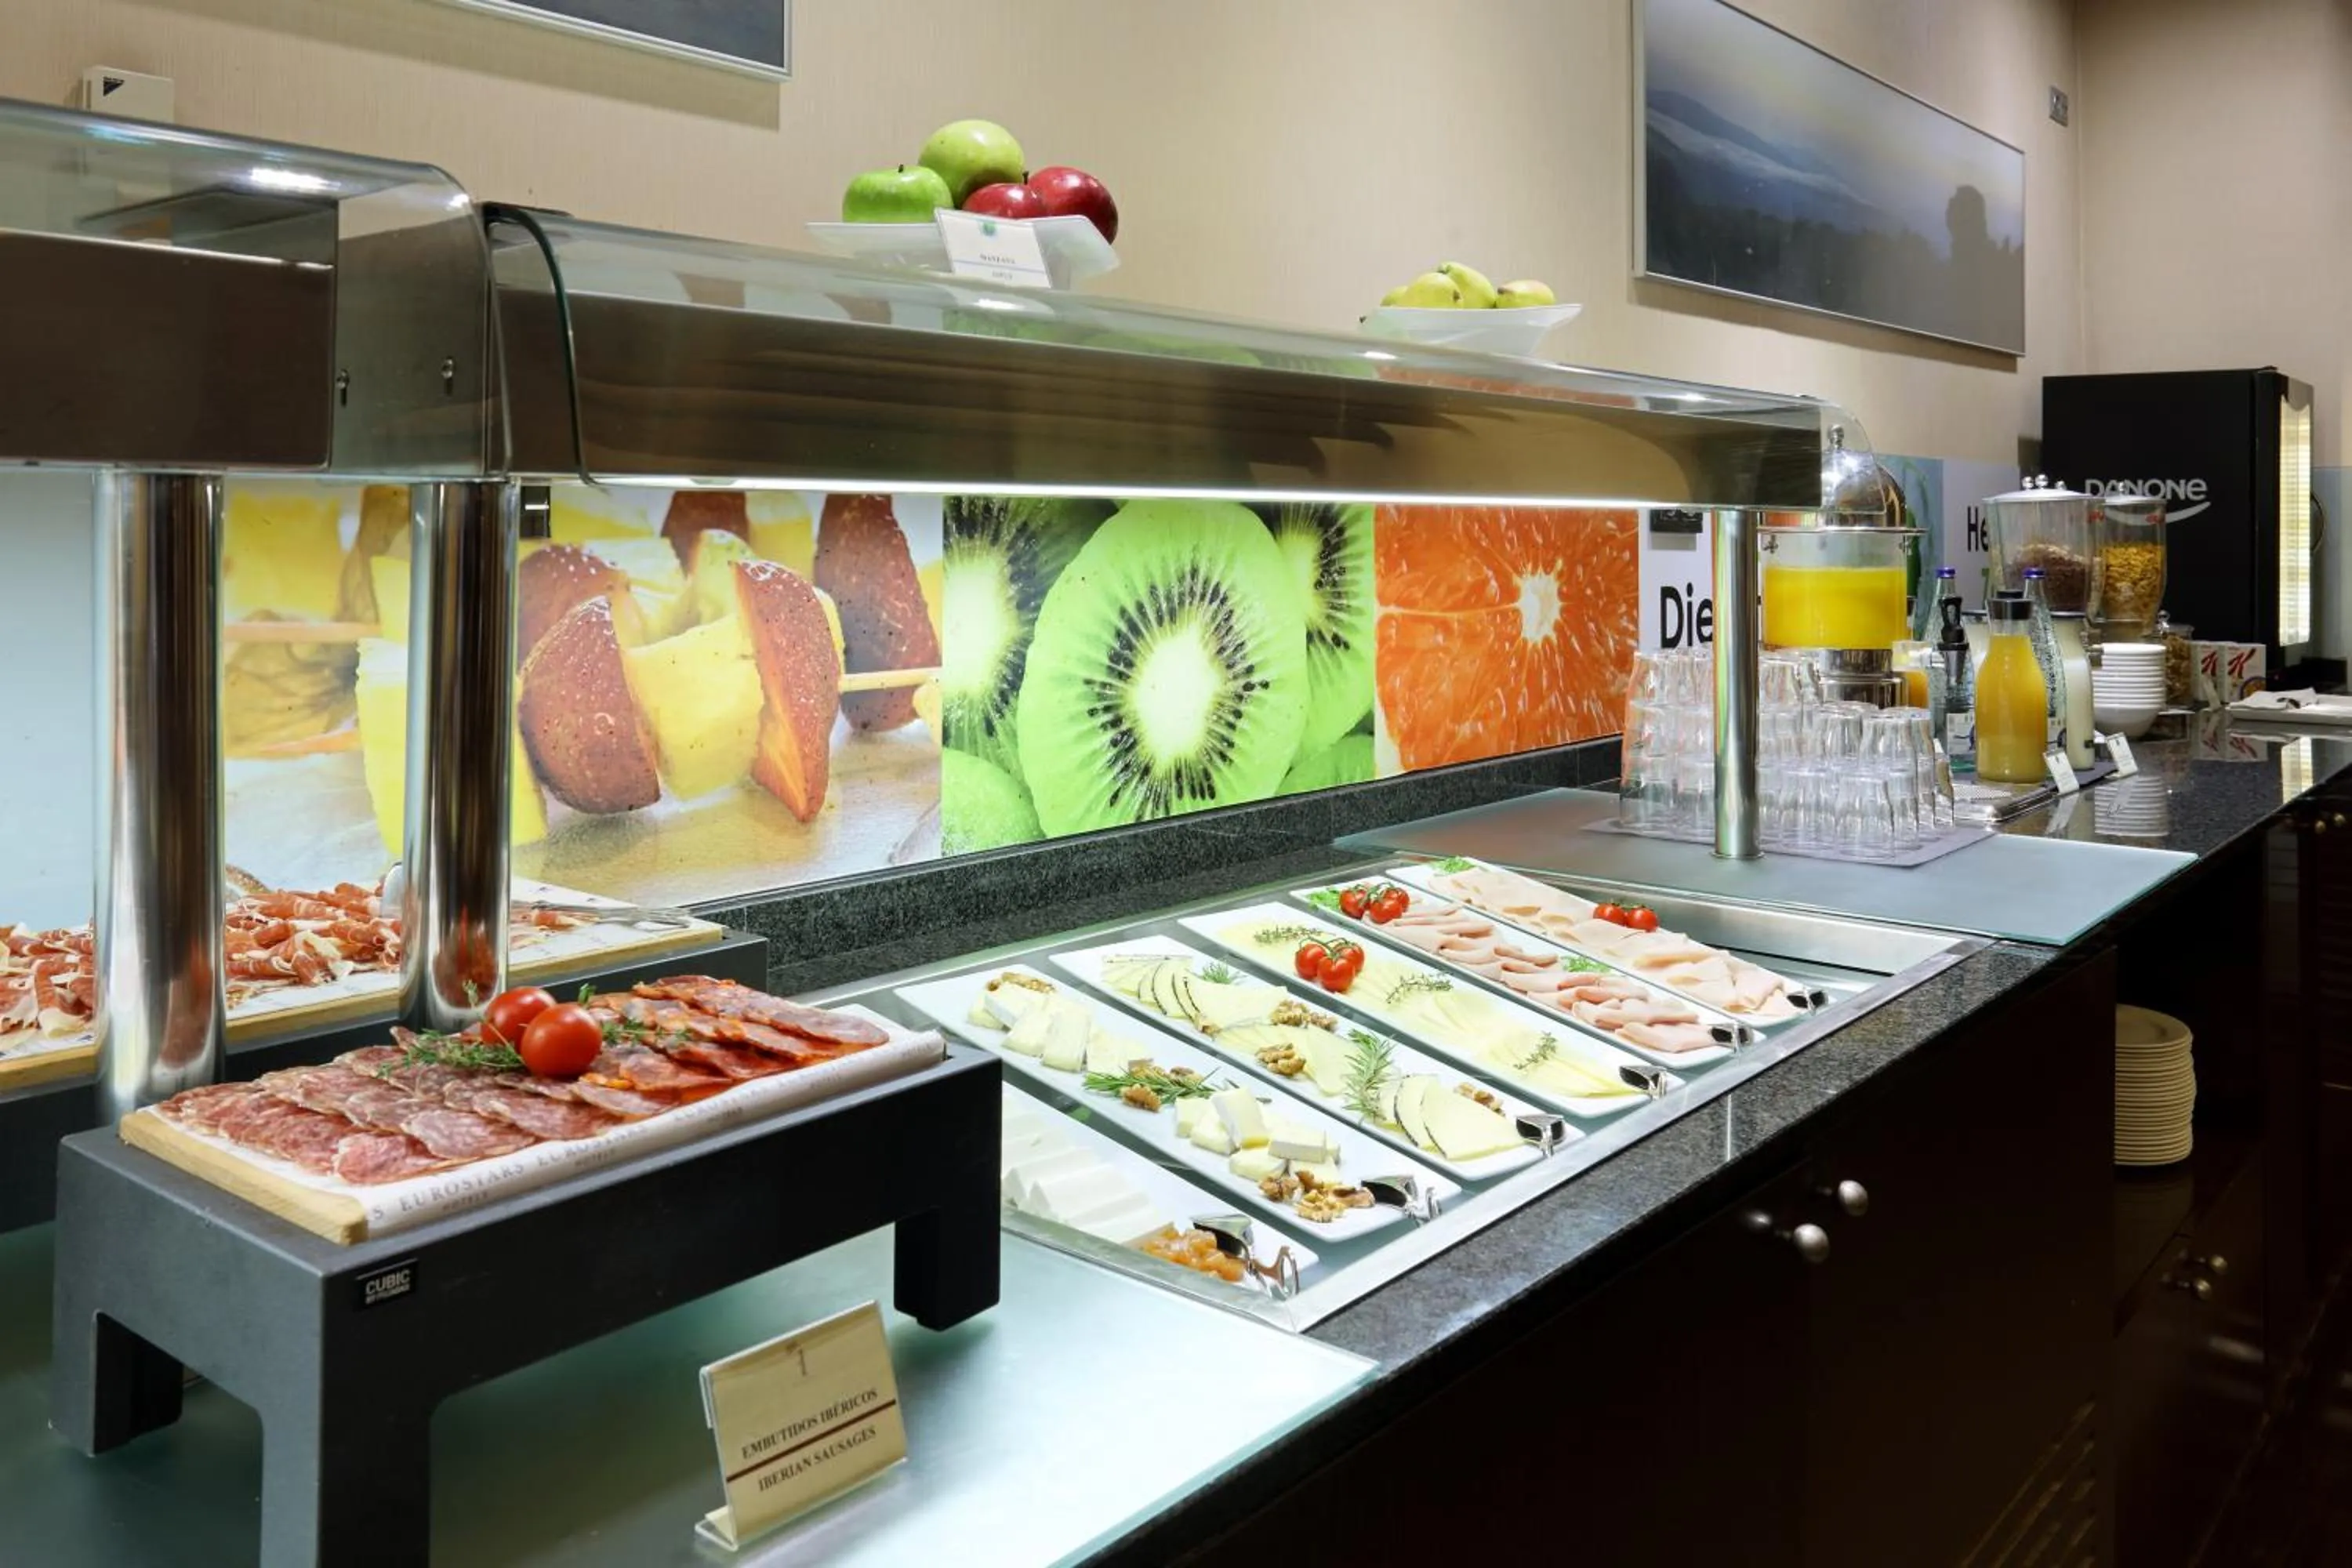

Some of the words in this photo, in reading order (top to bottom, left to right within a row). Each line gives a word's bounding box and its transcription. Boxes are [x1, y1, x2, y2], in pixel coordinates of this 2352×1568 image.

[398, 1163, 525, 1213] EUROSTARS
[365, 1269, 411, 1296] CUBIC
[741, 1417, 818, 1460] EMBUTIDOS
[757, 1455, 812, 1492] IBERIAN
[813, 1424, 877, 1465] SAUSAGES
